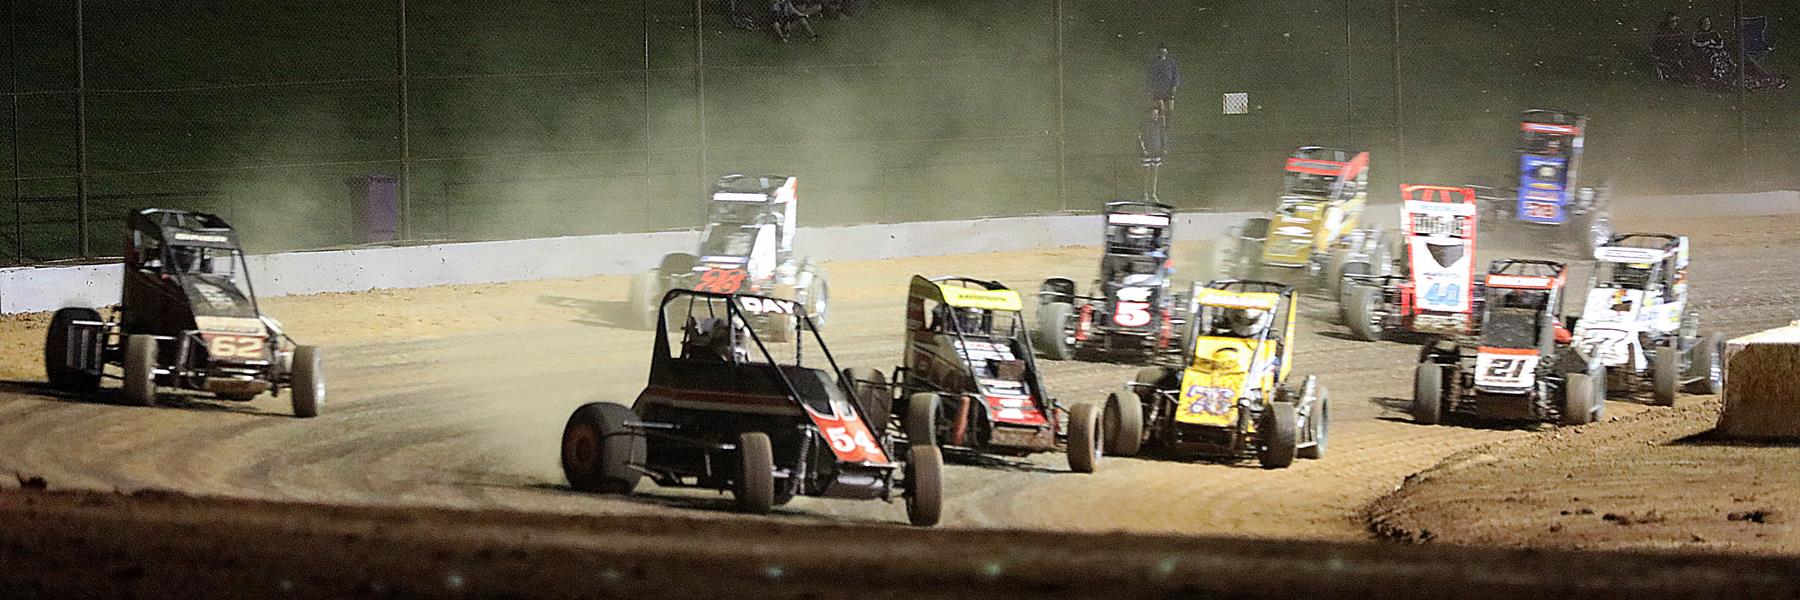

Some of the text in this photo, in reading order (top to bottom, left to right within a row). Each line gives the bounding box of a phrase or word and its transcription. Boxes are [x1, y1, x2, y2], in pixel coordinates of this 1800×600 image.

[739, 296, 796, 315] DAY
[1424, 282, 1461, 307] 40
[1113, 301, 1152, 328] 5
[210, 336, 263, 357] 62
[1486, 358, 1527, 379] 21
[826, 427, 881, 455] 54
